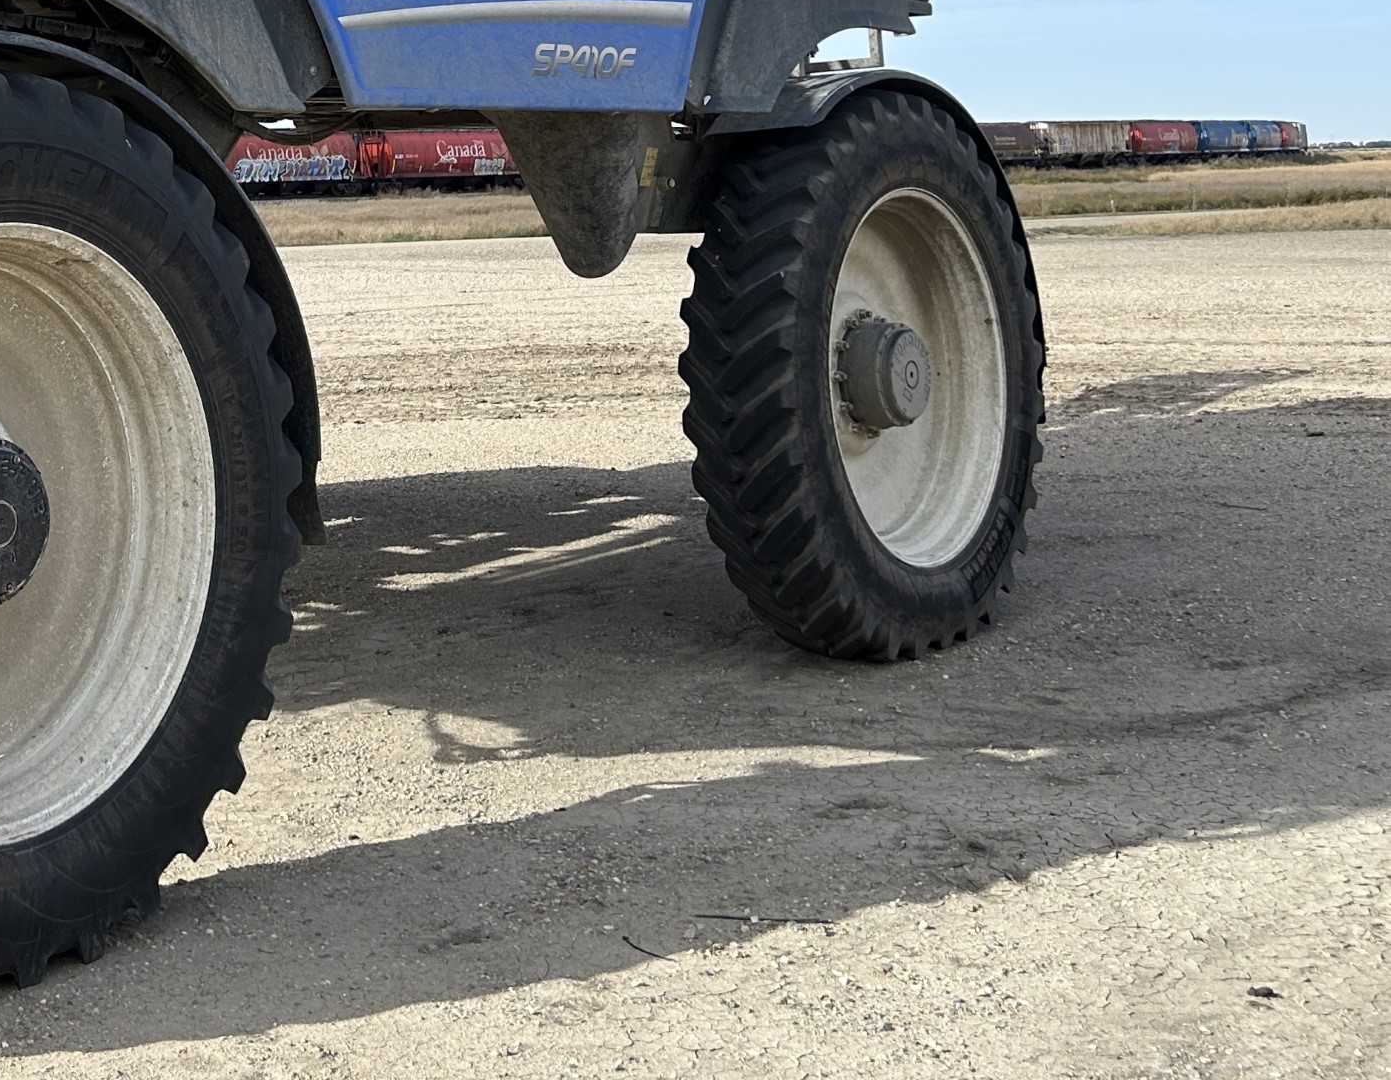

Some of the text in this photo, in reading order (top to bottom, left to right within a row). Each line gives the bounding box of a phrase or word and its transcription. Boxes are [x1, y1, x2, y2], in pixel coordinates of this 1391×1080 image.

[532, 43, 638, 79] SP410F
[246, 143, 303, 161] Canada
[437, 140, 486, 158] Canada
